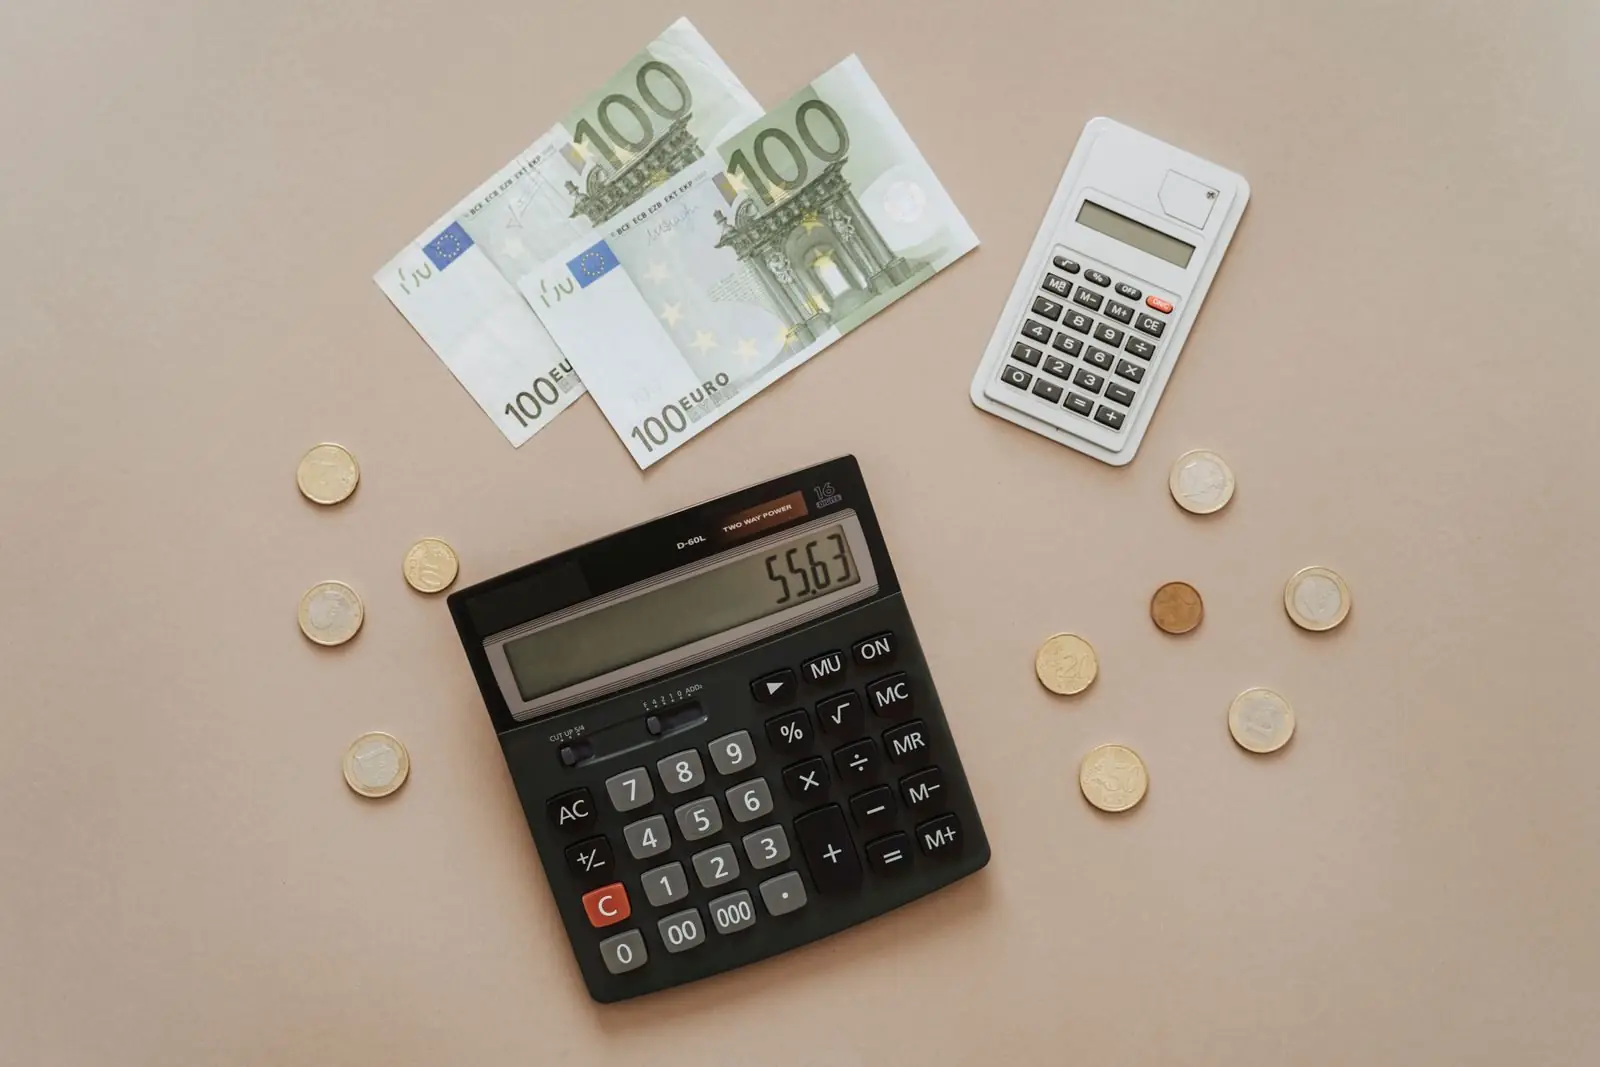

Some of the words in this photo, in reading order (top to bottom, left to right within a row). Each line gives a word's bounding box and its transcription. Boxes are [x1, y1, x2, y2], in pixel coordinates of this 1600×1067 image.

[573, 60, 693, 171] 100
[727, 99, 850, 206] 100
[632, 212, 647, 224] ECB
[648, 201, 662, 214] EZB
[664, 190, 678, 203] EKT
[679, 180, 693, 193] EKP
[1121, 285, 1138, 295] OFF
[1043, 302, 1054, 313] 7
[1111, 305, 1128, 318] M+
[1031, 326, 1043, 337] 4
[1073, 316, 1085, 327] 8
[1143, 319, 1159, 332] CE
[1063, 339, 1074, 350] 5
[1104, 329, 1116, 340] 9
[1024, 348, 1032, 359] 1
[1094, 352, 1105, 363] 6
[1053, 361, 1065, 374] 2
[1084, 374, 1096, 386] 3
[505, 377, 559, 428] 100
[631, 404, 687, 452] 100
[678, 372, 729, 411] EURO
[814, 482, 835, 500] 16
[722, 521, 743, 533] TWO
[743, 514, 762, 526] WAY
[762, 504, 792, 518] POWER
[676, 535, 707, 550] D-60L
[765, 533, 851, 604] 55.63
[860, 637, 891, 660] ON
[810, 655, 841, 679] MU
[875, 682, 909, 707] MC
[550, 732, 563, 742] CUT
[780, 722, 803, 744] %
[892, 732, 926, 755] MR
[726, 742, 743, 764] 9
[676, 761, 693, 783] 8
[622, 779, 637, 801] 7
[744, 790, 761, 811] 6
[559, 800, 589, 825] AC
[692, 808, 710, 832] 5
[641, 827, 658, 848] 4
[760, 837, 778, 860] 3
[924, 826, 956, 851] M+
[710, 856, 729, 879] 2
[659, 875, 673, 896] 1
[598, 895, 618, 917] C
[716, 900, 752, 928] 000
[668, 920, 697, 945] 00
[616, 943, 633, 964] 0
